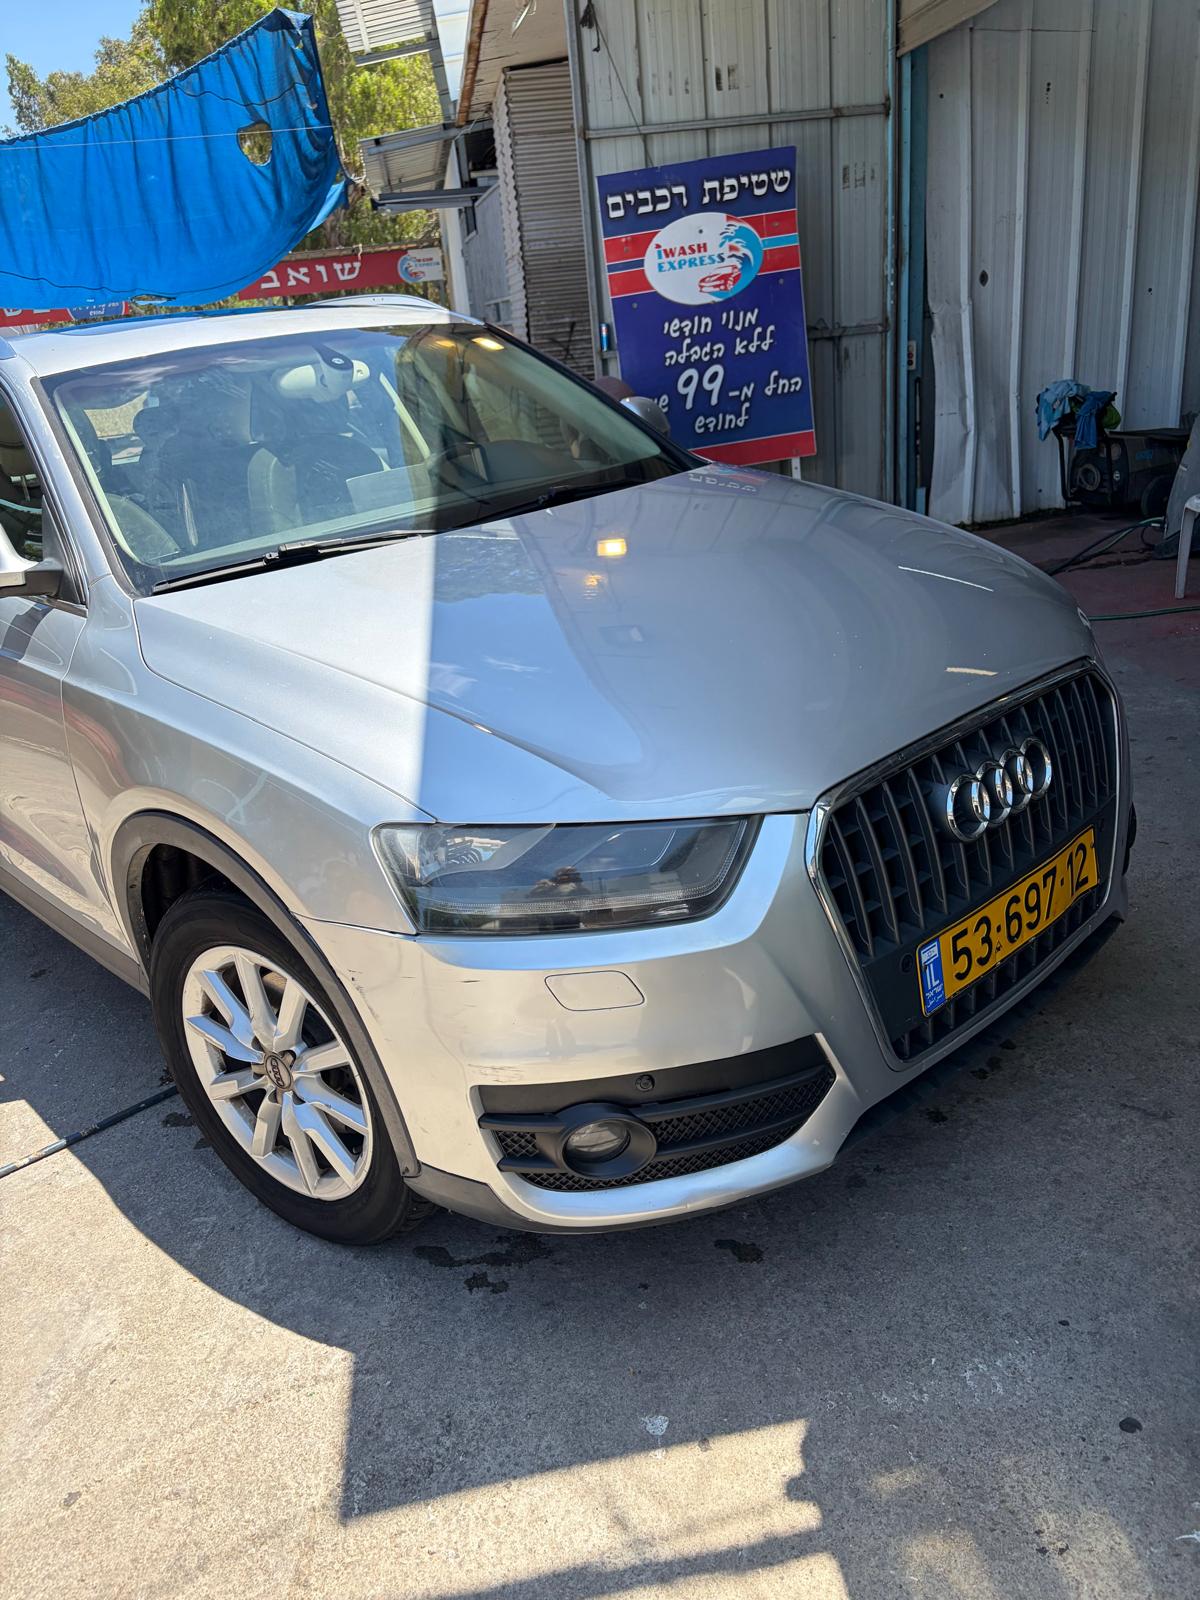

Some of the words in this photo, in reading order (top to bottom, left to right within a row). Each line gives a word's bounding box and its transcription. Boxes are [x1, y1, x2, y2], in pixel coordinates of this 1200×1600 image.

[701, 168, 792, 205] שטיפת
[606, 184, 689, 219] רכבים
[657, 252, 726, 273] EXPRESS
[663, 315, 713, 338] חודשי
[721, 307, 759, 331] מנוי
[664, 338, 725, 367] הגבלה
[734, 324, 776, 355] ללא
[764, 370, 802, 396] החל
[694, 401, 751, 434] לחודש
[926, 962, 940, 991] IL
